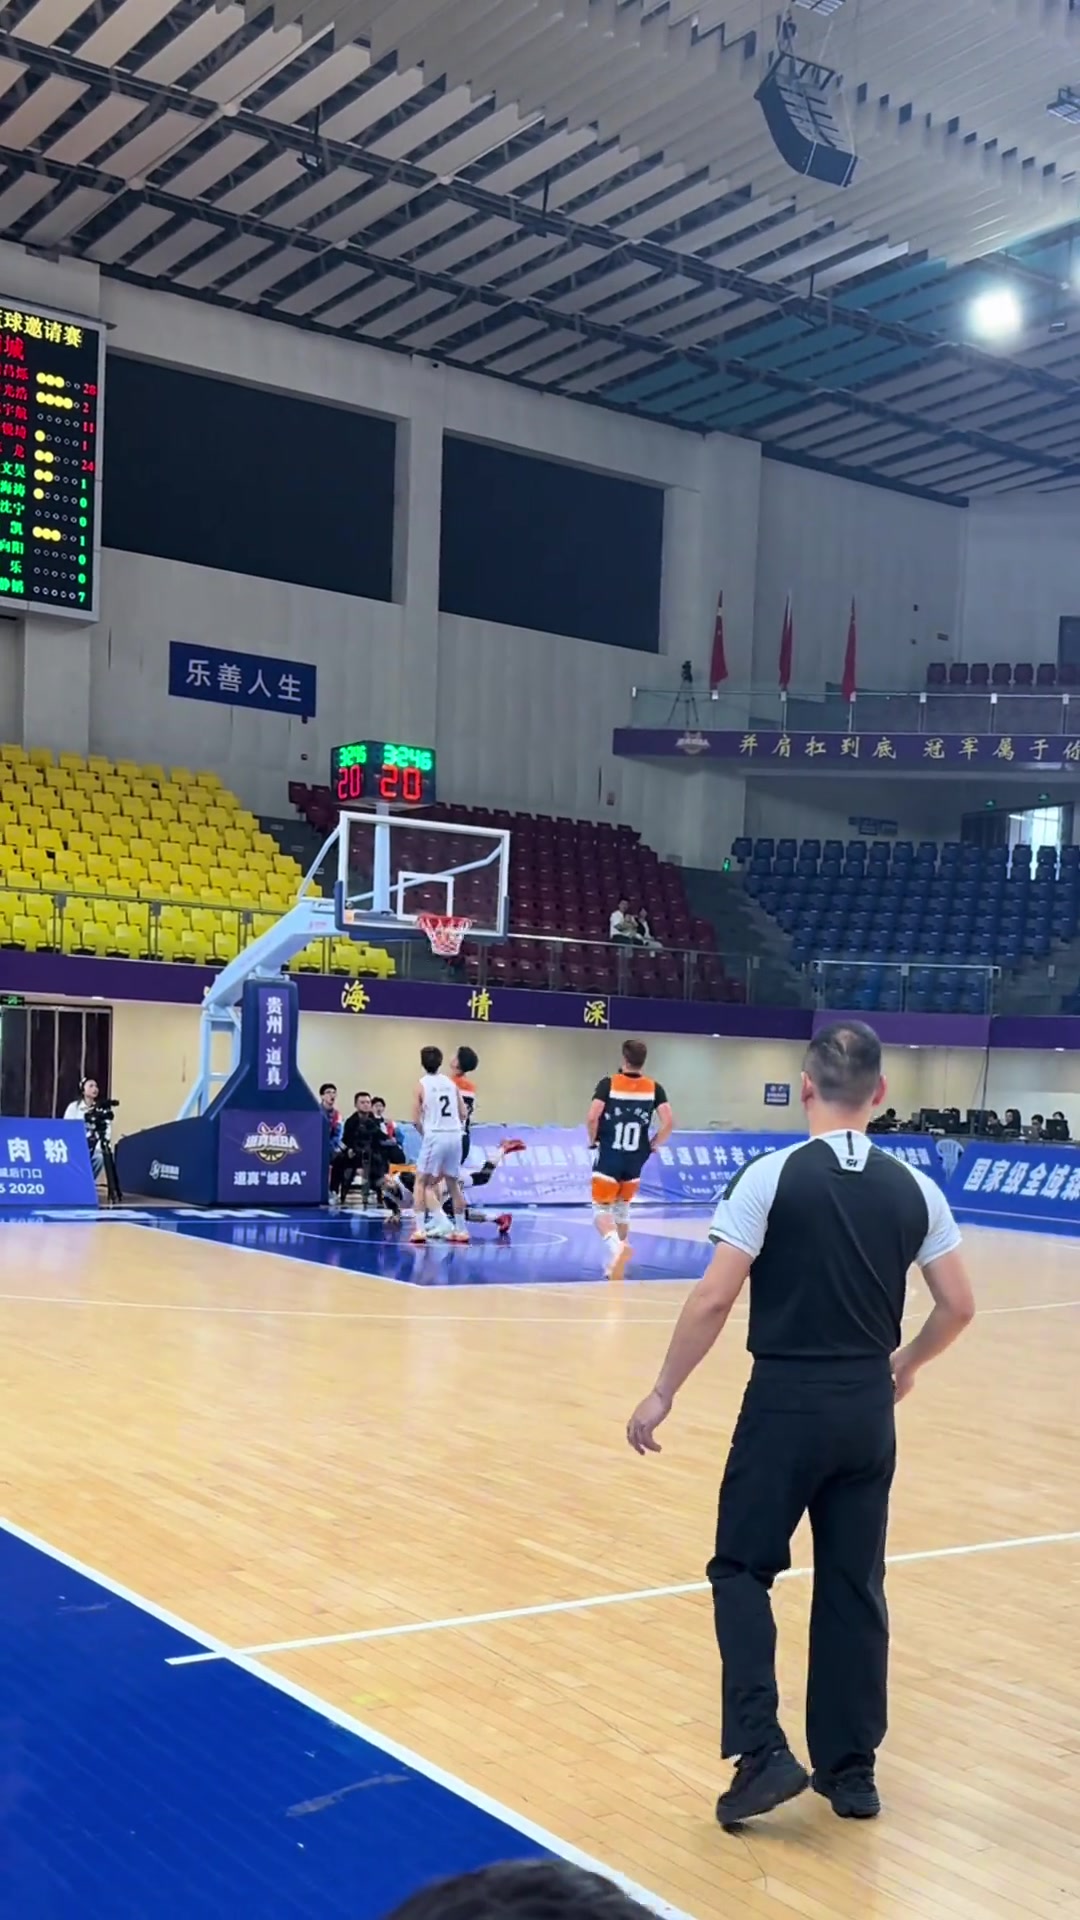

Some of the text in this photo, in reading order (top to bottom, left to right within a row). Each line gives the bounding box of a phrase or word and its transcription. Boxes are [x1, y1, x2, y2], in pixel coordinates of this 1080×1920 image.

[0, 310, 83, 348] 球邀请赛
[83, 402, 90, 413] 2
[81, 459, 95, 472] 24
[81, 478, 87, 490] 1
[80, 497, 88, 509] 0
[79, 516, 87, 528] 0
[80, 535, 85, 547] 1
[78, 554, 86, 565] 0
[78, 573, 86, 584] 0
[185, 659, 302, 702] 乐善人生
[738, 733, 897, 760] 并肩扛到底
[338, 763, 361, 799] 20
[380, 763, 422, 801] 20
[439, 1095, 452, 1117] 2
[611, 1121, 641, 1151] 10
[9, 1182, 45, 1195] 2020
